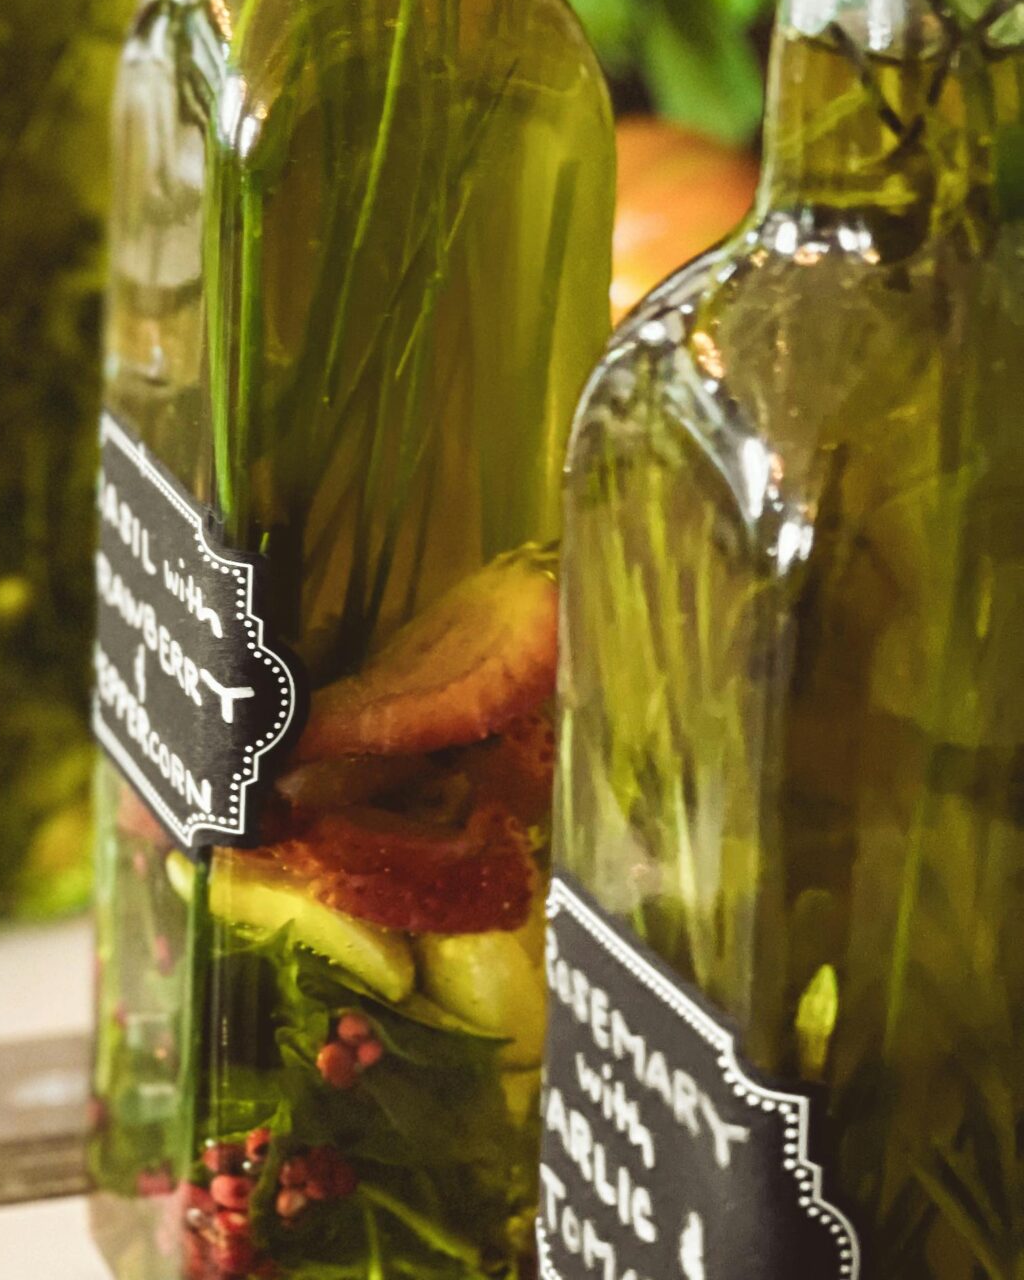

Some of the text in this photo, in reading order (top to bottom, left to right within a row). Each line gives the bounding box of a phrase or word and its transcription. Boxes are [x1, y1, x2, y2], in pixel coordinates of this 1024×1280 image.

[163, 557, 223, 639] with
[540, 1086, 657, 1244] ARLIC
[575, 1052, 655, 1169] with
[539, 1162, 637, 1280] TOM
